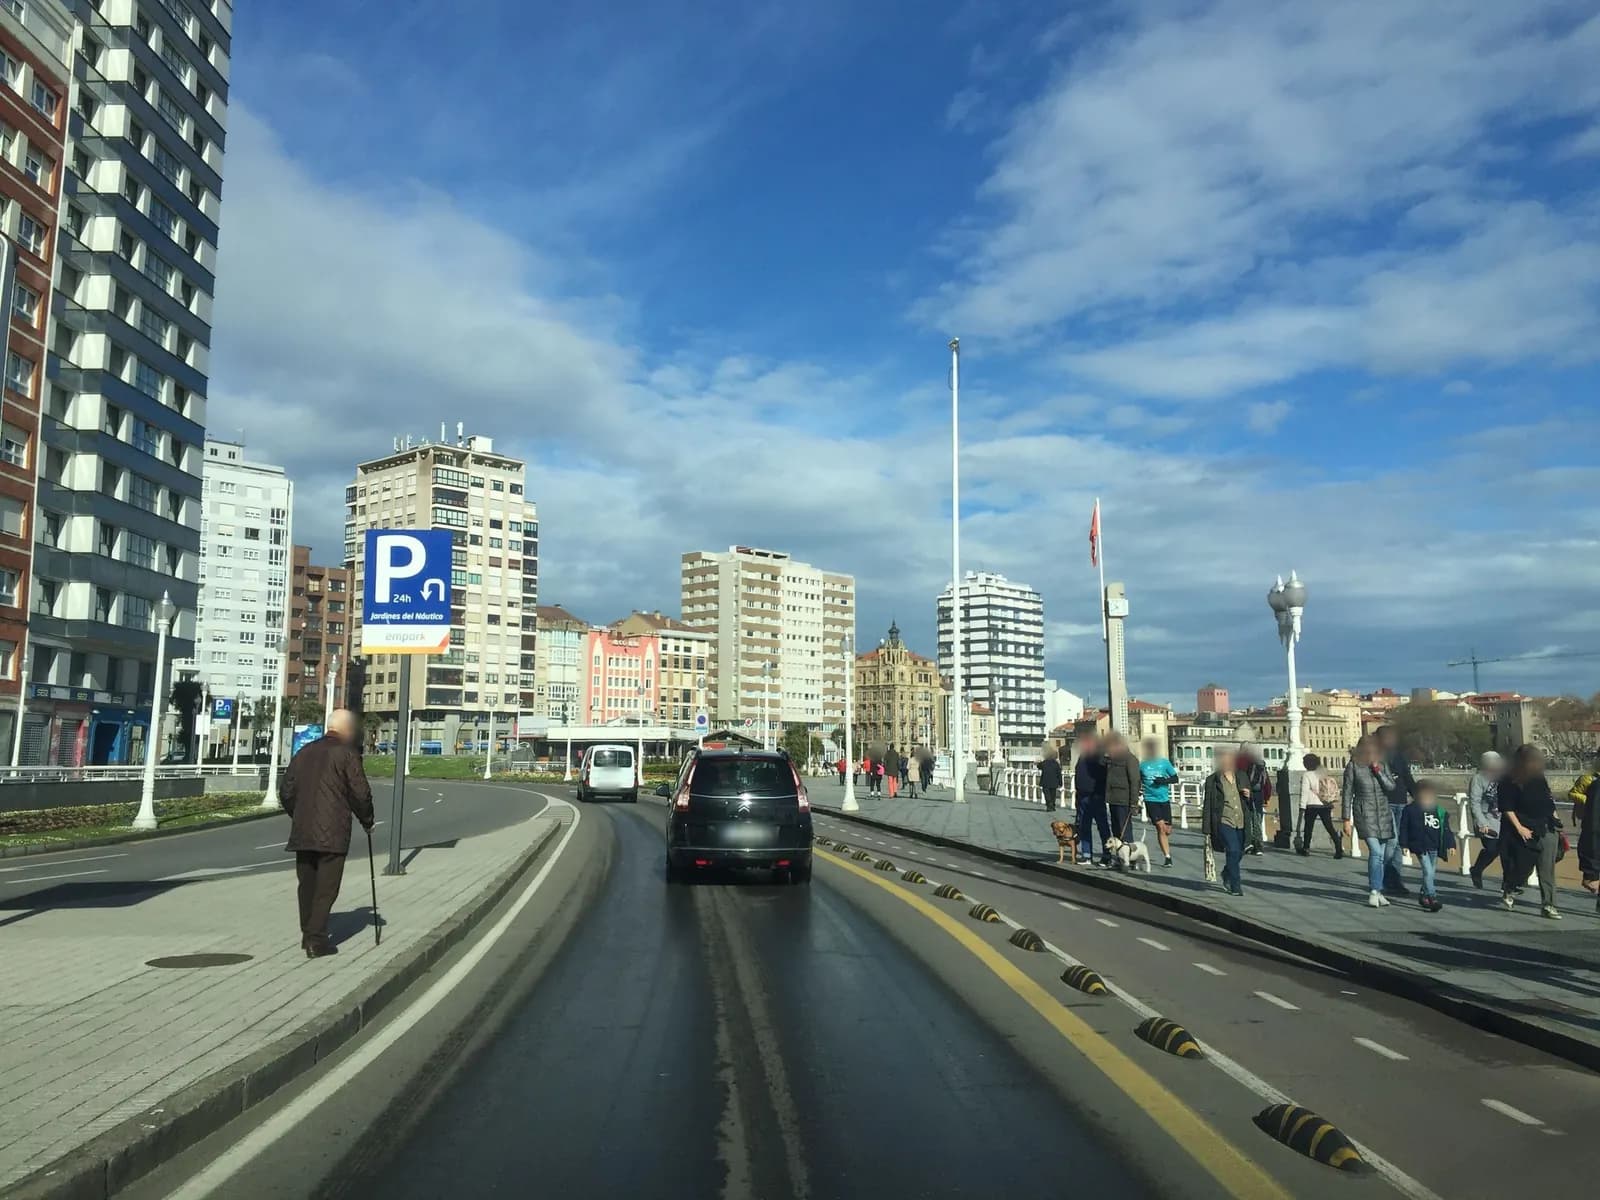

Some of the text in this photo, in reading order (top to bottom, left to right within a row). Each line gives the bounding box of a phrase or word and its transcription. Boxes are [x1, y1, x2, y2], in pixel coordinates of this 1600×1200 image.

[375, 534, 427, 603] P
[393, 593, 412, 603] 24h
[370, 612, 444, 621] Jardines del Náutico
[385, 632, 426, 643] empark
[215, 699, 225, 711] P
